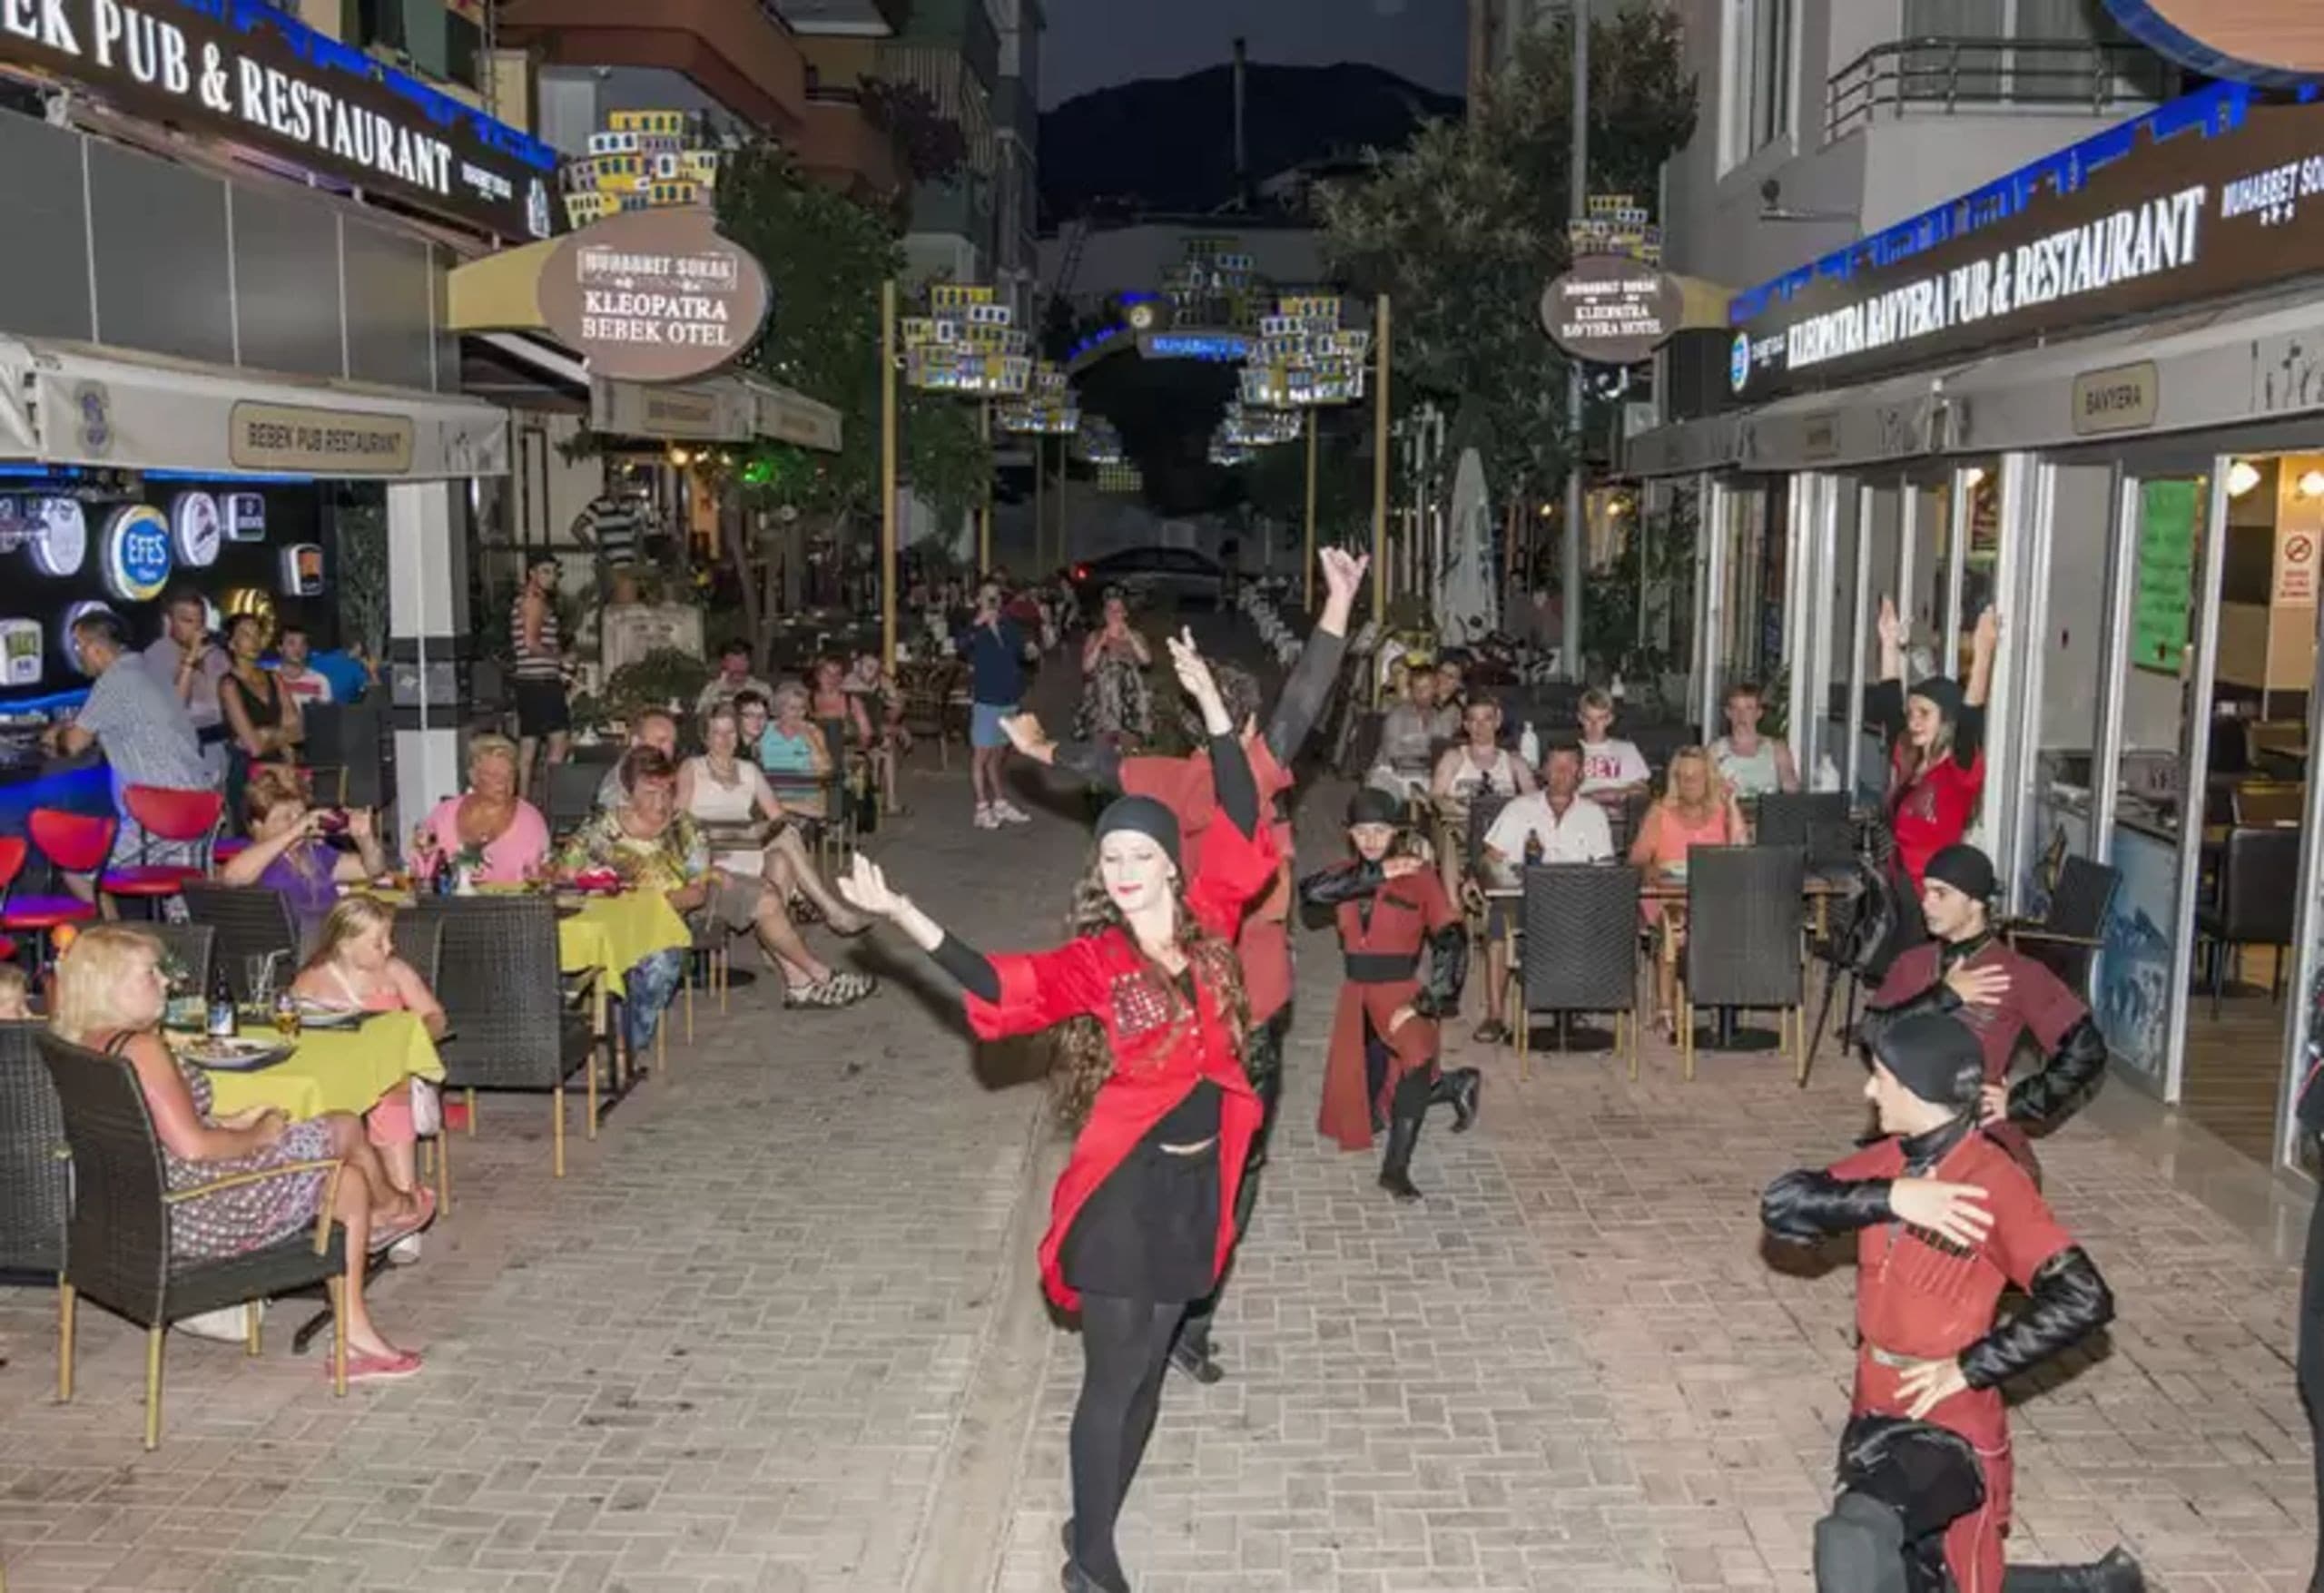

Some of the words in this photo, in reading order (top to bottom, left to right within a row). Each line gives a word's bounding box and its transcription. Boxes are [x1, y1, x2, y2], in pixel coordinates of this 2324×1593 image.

[94, 0, 190, 93] PUB
[201, 42, 231, 112] &
[238, 55, 452, 194] RESTAURANT
[1948, 259, 1991, 326] PUB
[1992, 251, 2012, 316] &
[2014, 184, 2207, 309] RESTAURANT
[584, 290, 729, 321] KLEOPATRA
[582, 317, 662, 342] BEBEK
[667, 322, 732, 346] OTEL
[248, 421, 292, 449] BEBEK
[297, 425, 322, 451] PUB
[326, 428, 402, 454] RESTAURANT
[127, 533, 167, 564] EFES
